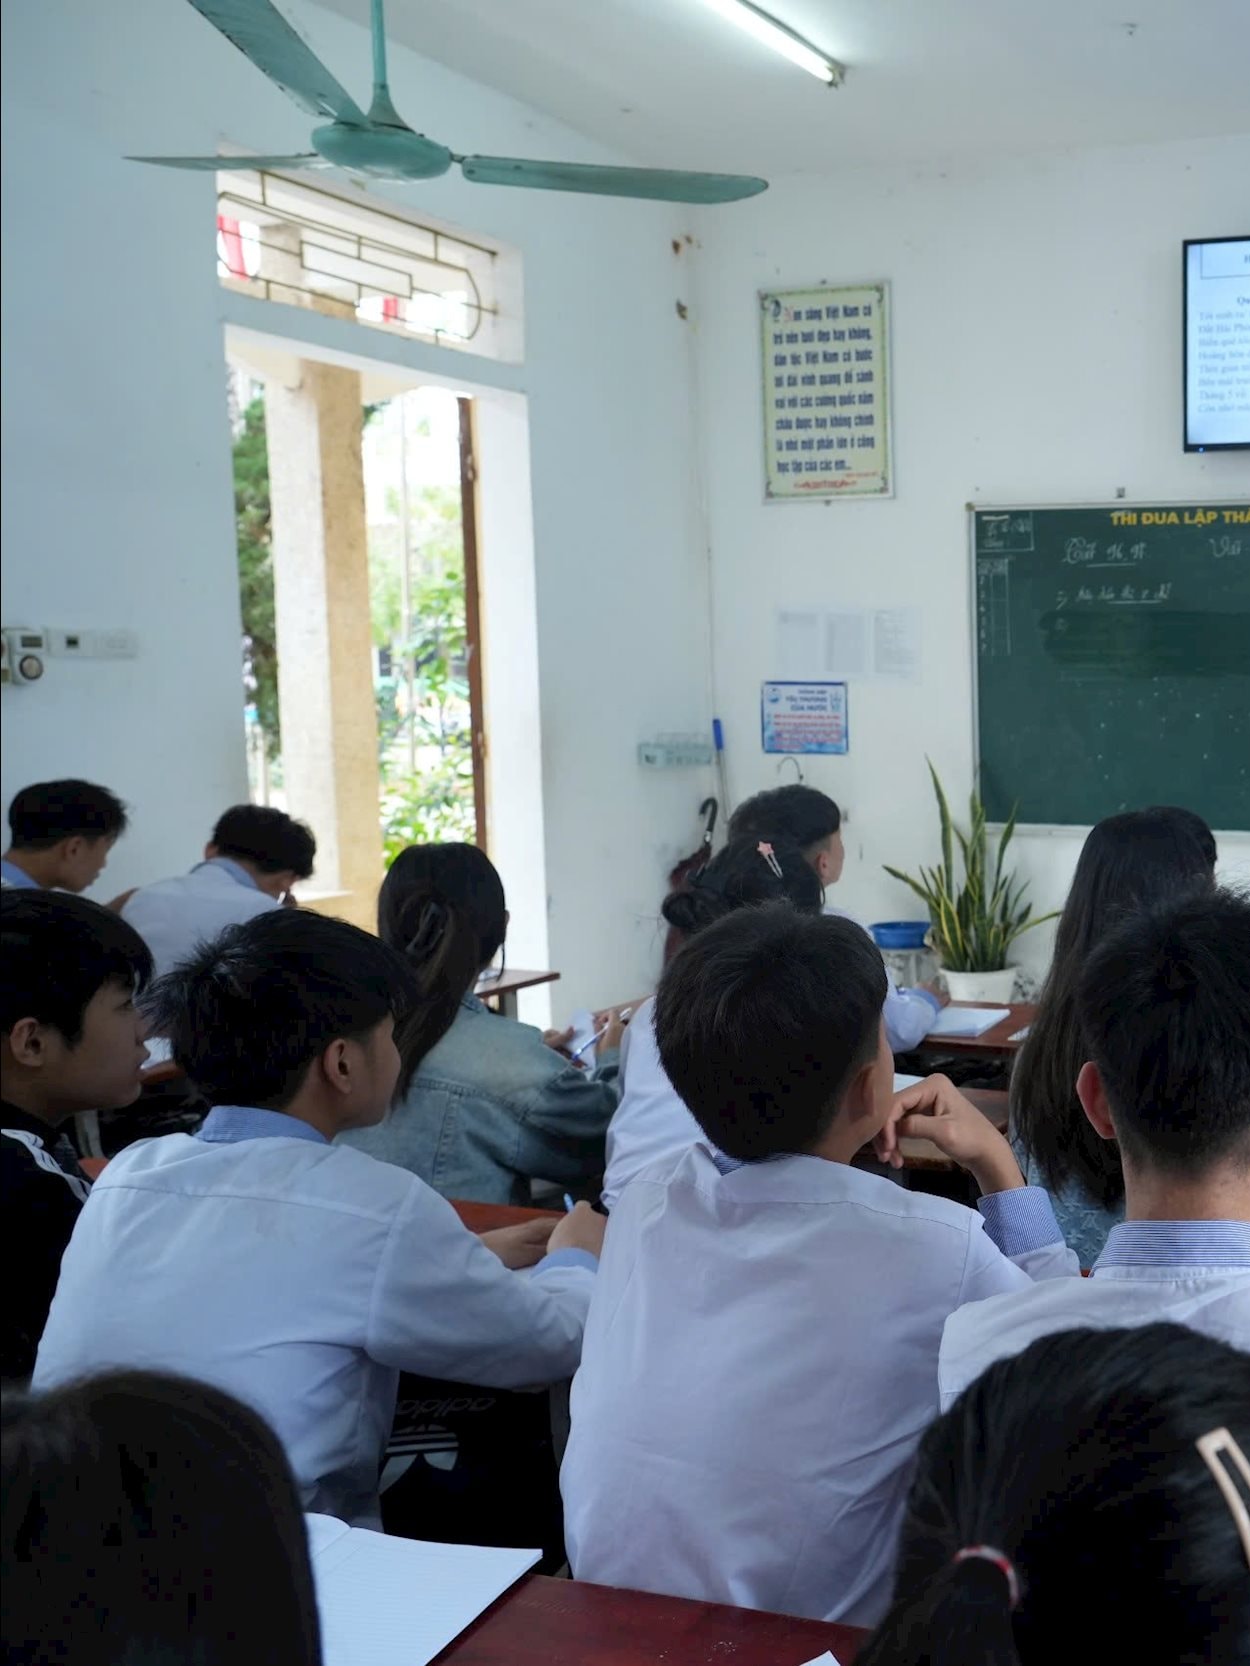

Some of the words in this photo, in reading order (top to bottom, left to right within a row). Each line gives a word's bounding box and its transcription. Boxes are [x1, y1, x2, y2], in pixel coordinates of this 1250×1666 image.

[842, 304, 859, 317] Nam
[822, 350, 839, 363] Nam
[1110, 511, 1137, 525] THI
[1184, 508, 1218, 527] LẬP
